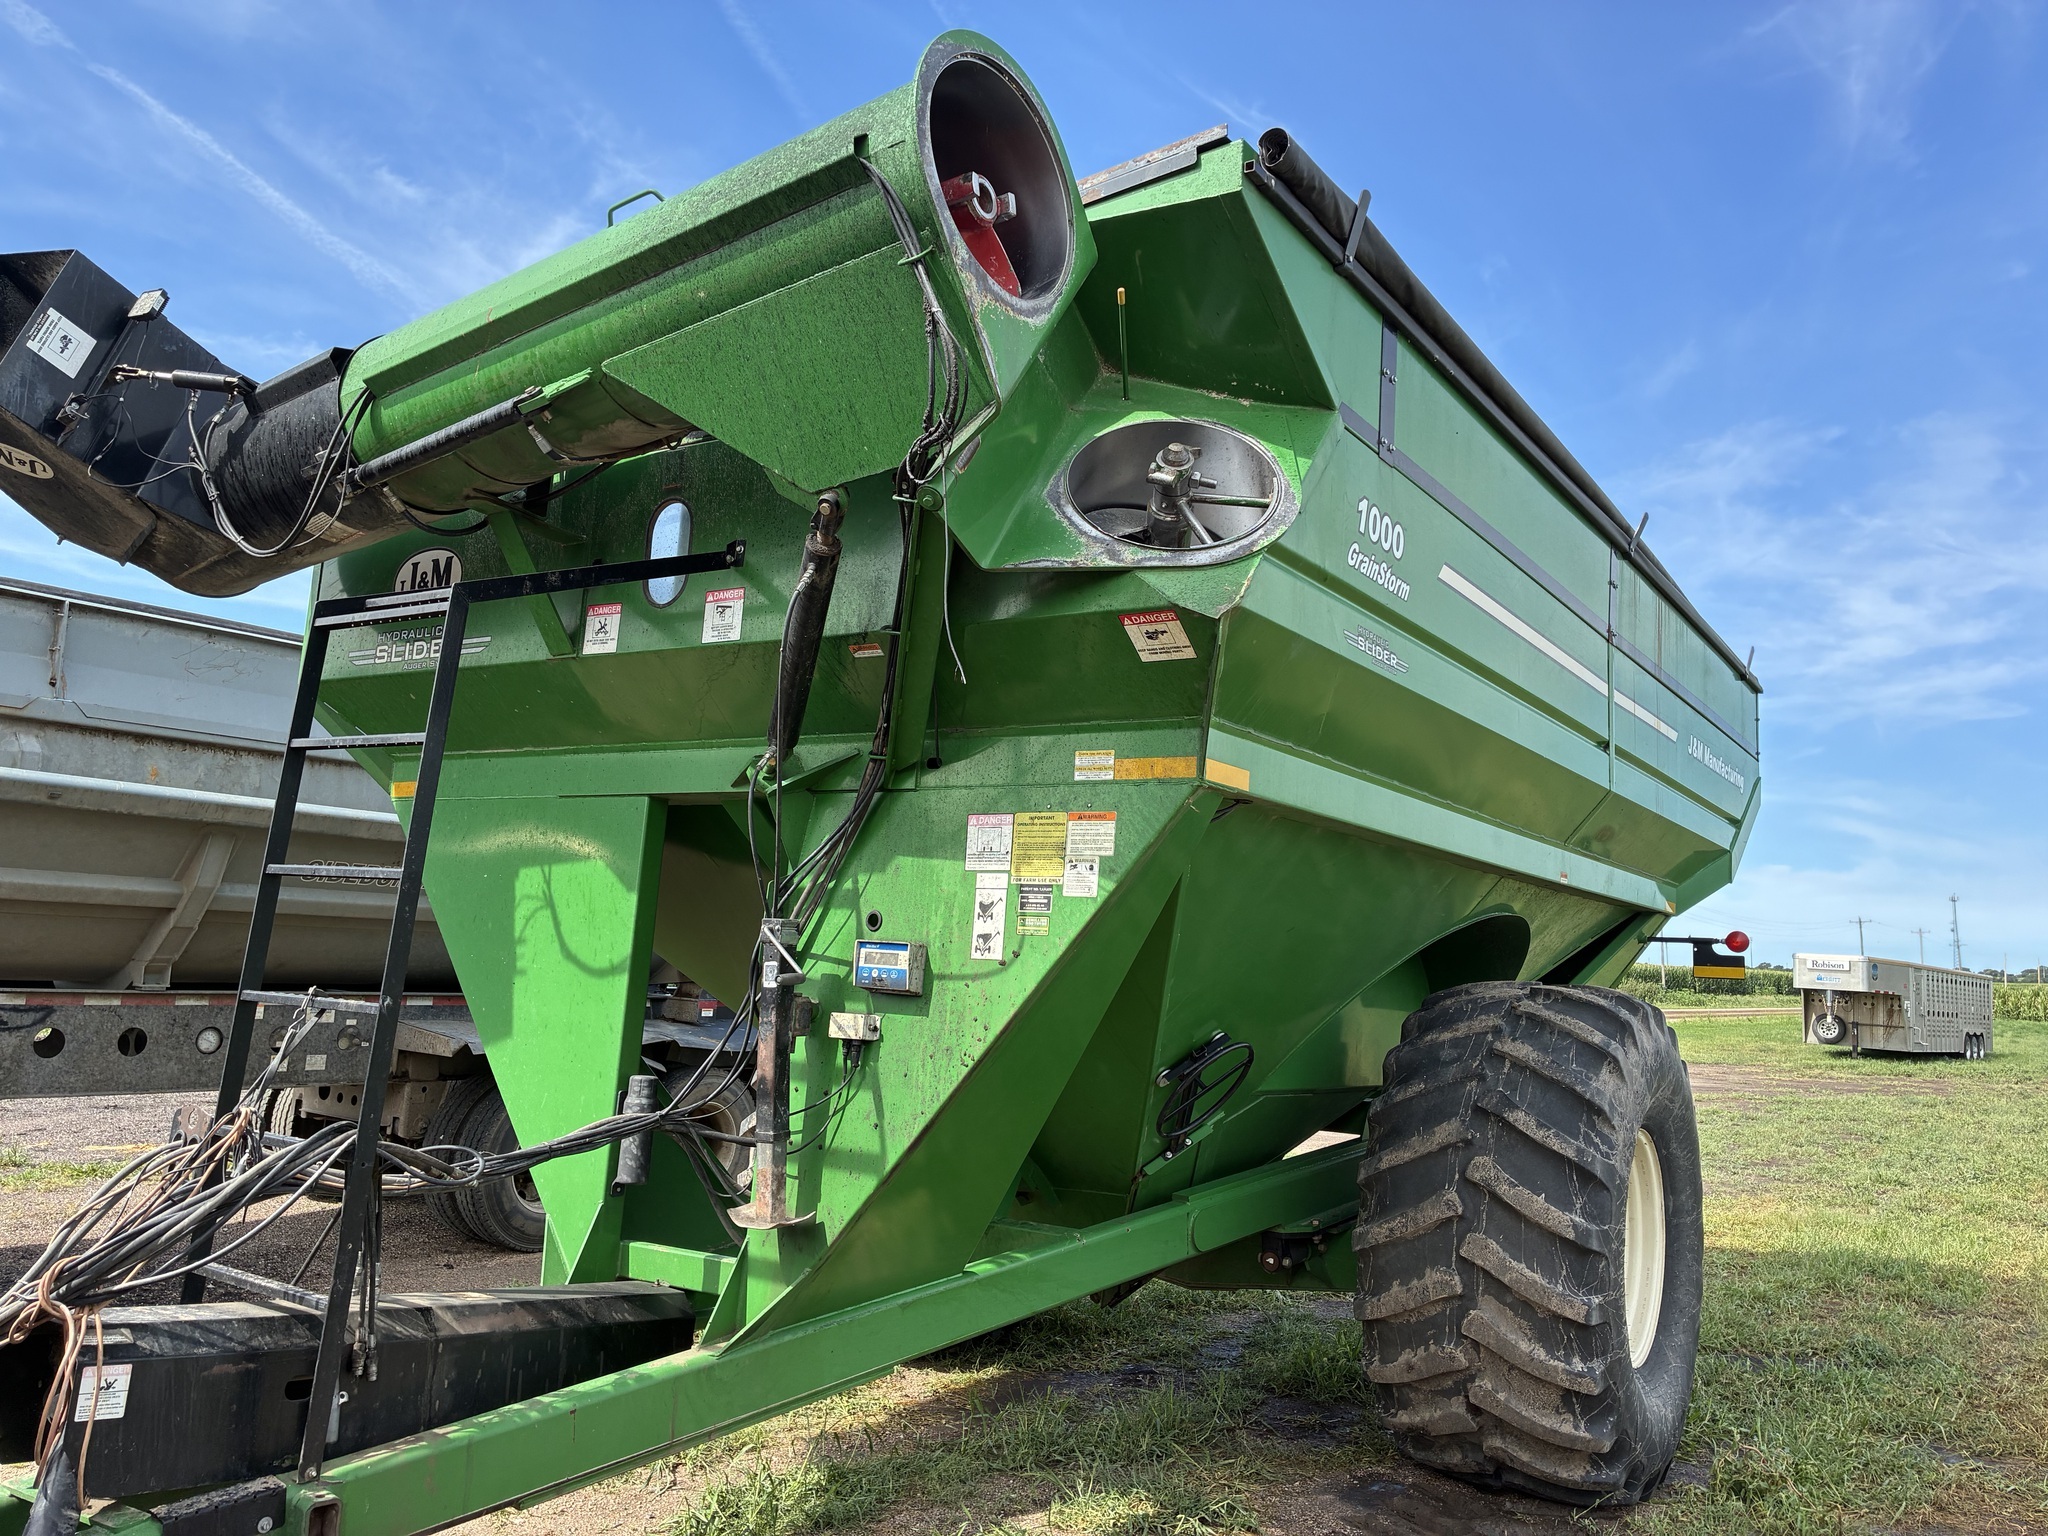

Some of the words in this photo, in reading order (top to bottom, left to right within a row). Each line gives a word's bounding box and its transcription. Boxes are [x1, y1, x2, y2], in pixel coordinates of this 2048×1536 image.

[1357, 497, 1405, 560] 1000
[1347, 542, 1411, 602] GrainStorm
[713, 589, 744, 600] DANGER
[593, 605, 622, 615] DANGER
[1132, 612, 1177, 624] DANGER
[377, 626, 443, 643] HYDRAULIC
[374, 639, 442, 664] SLIDE
[1358, 636, 1397, 668] SLIDER
[403, 661, 427, 670] AUGER
[1687, 734, 1703, 762] J&M
[1704, 745, 1744, 794] Manufacturing
[979, 816, 1012, 825] DANGER
[1811, 959, 1844, 969] Robison
[99, 1366, 130, 1375] ANGER
